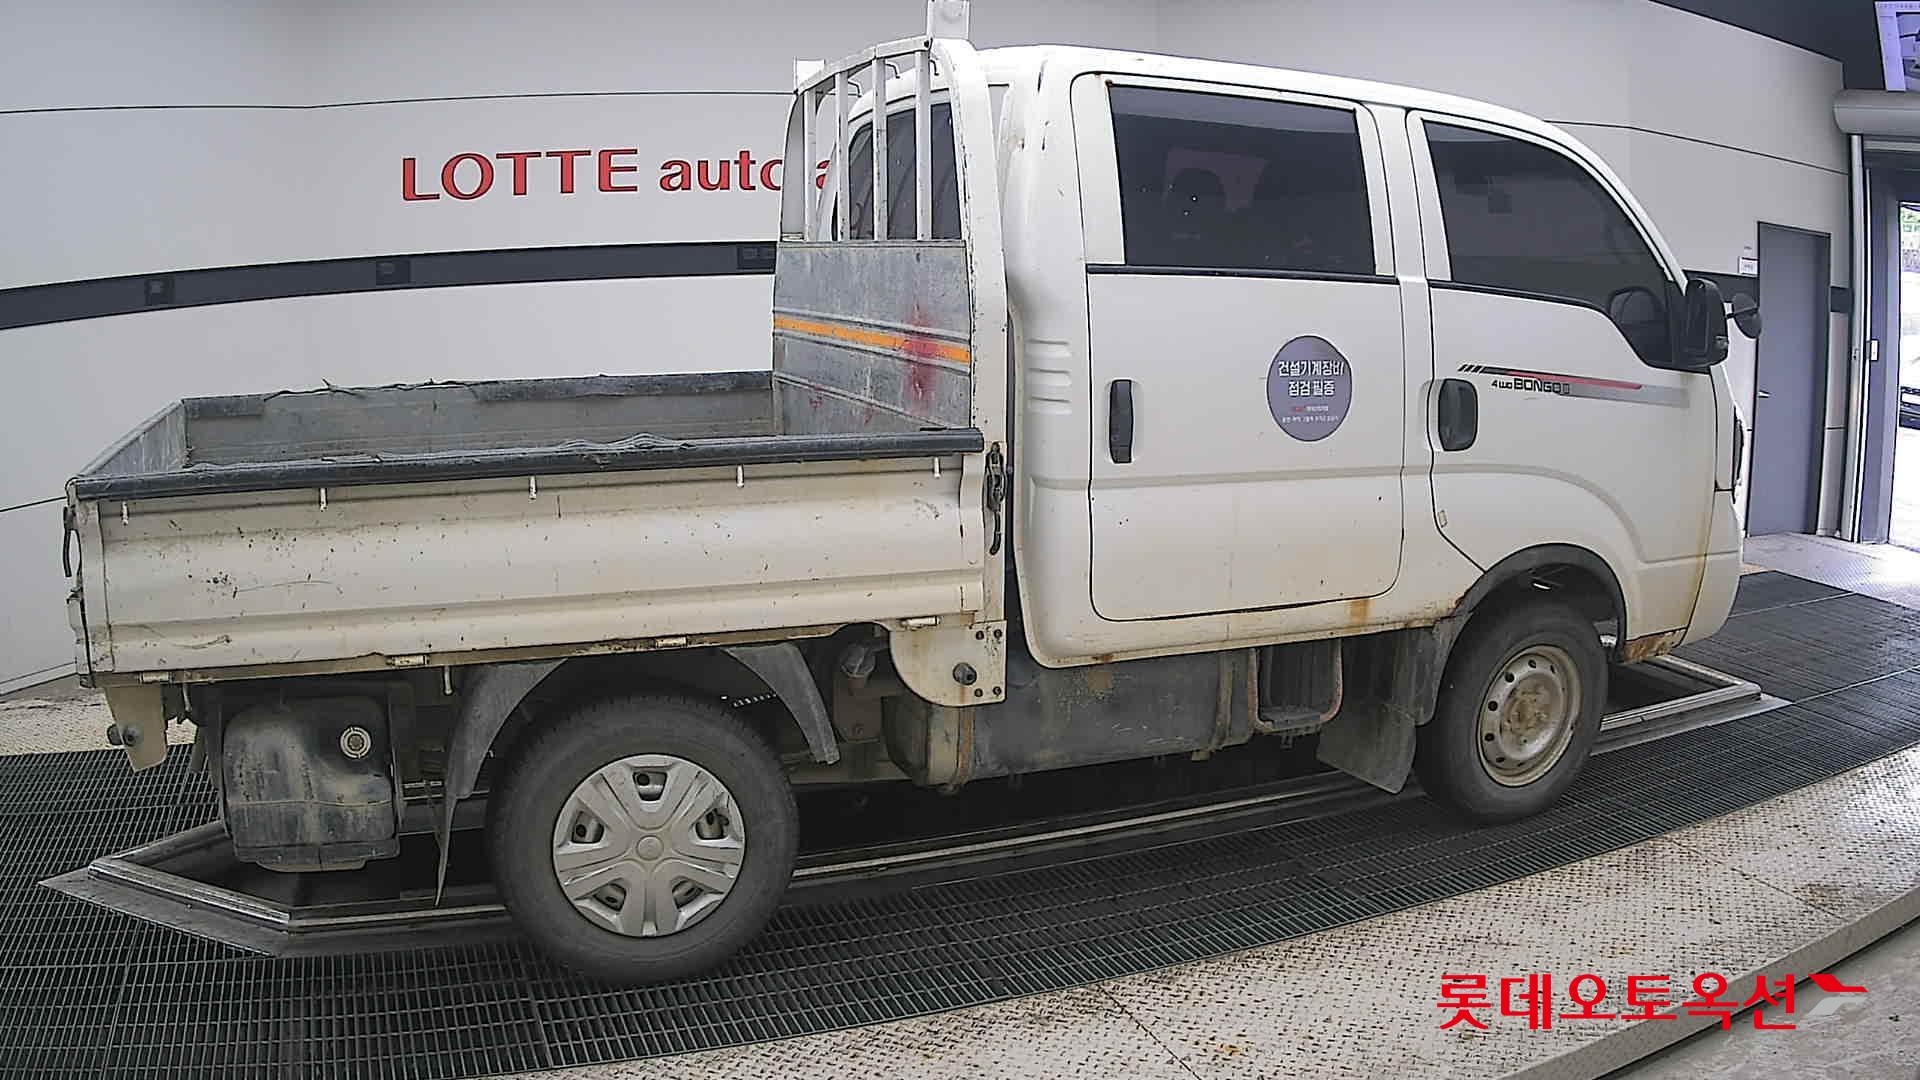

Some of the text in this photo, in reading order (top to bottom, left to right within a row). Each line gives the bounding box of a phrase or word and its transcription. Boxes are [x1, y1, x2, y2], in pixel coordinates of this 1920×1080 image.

[402, 148, 639, 202] LOTTE
[1278, 360, 1345, 377] 건설기계장비
[1288, 379, 1311, 397] 점검
